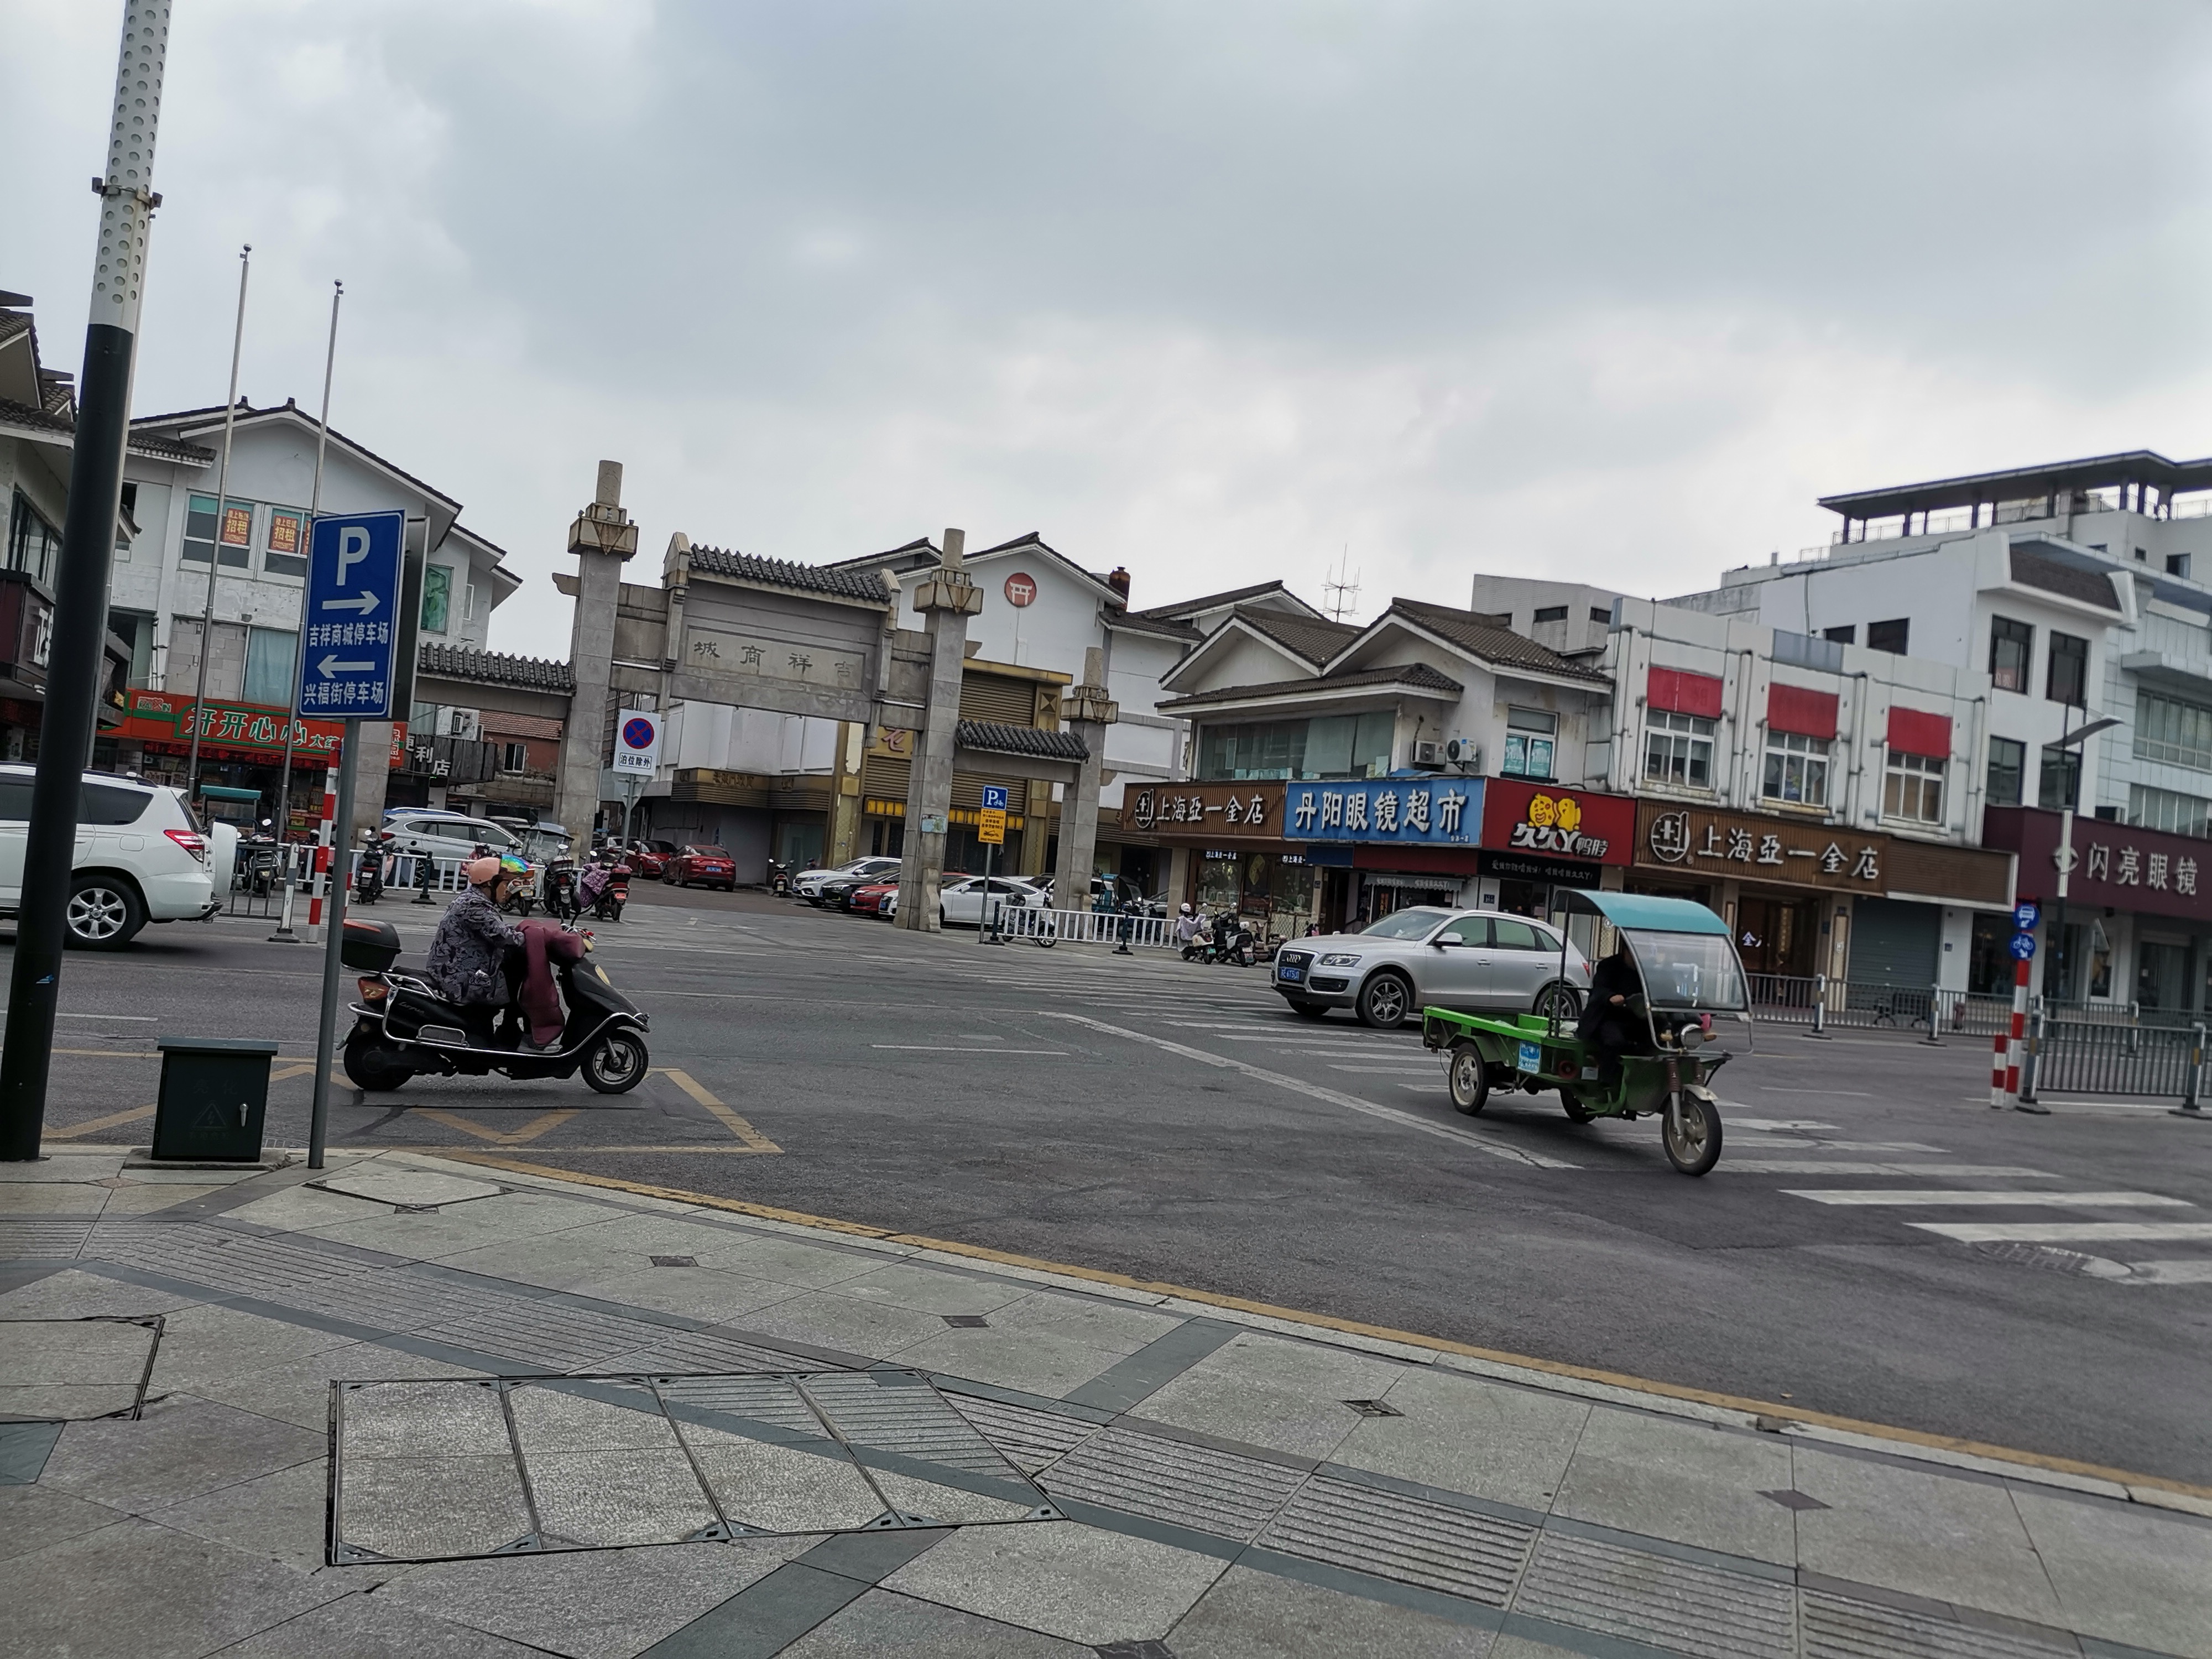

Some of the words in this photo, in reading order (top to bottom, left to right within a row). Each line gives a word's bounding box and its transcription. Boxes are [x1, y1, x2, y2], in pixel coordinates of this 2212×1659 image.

[226, 518, 247, 535] 招租
[274, 526, 295, 542] 招租
[336, 526, 371, 586] P
[309, 622, 388, 647] 吉祥商城停车场
[304, 681, 384, 705] 兴福街停车场
[620, 755, 650, 768] 泊位除外
[987, 790, 999, 805] P
[1295, 788, 1465, 833] 丹阳眼镜超市
[2087, 841, 2198, 896] 闪亮眼镜
